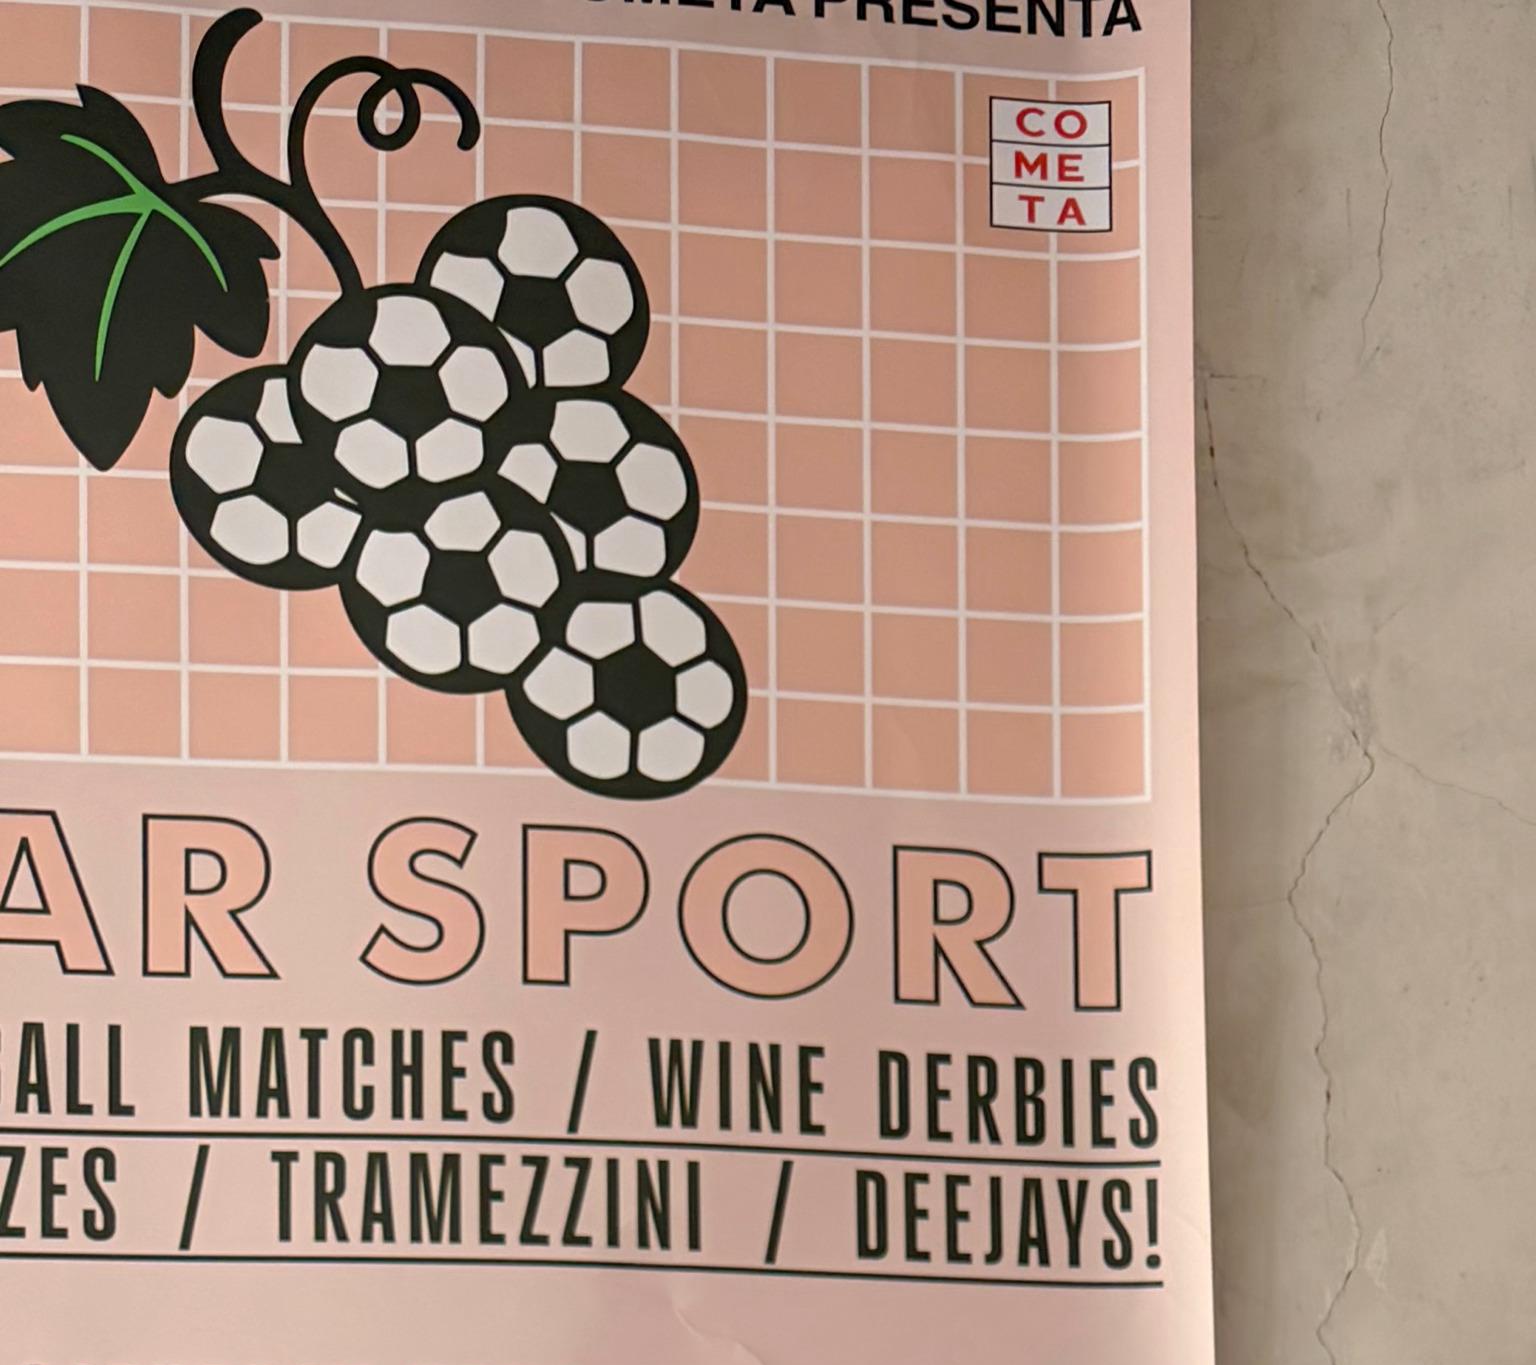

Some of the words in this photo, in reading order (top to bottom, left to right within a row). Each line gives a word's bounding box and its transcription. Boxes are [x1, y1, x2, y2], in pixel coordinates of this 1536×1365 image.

[1016, 107, 1087, 139] CO
[1014, 151, 1085, 183] ME
[1018, 195, 1087, 226] TA
[0, 808, 280, 979] AR
[359, 817, 1152, 1012] SPORT
[190, 1026, 514, 1123] MATCHES
[648, 1038, 825, 1135] WINE
[878, 1050, 1157, 1148] DERBIES
[0, 1146, 116, 1241] ZES
[271, 1151, 703, 1251] TRAMEZZINI
[857, 1171, 1160, 1268] DEEJAYS!
